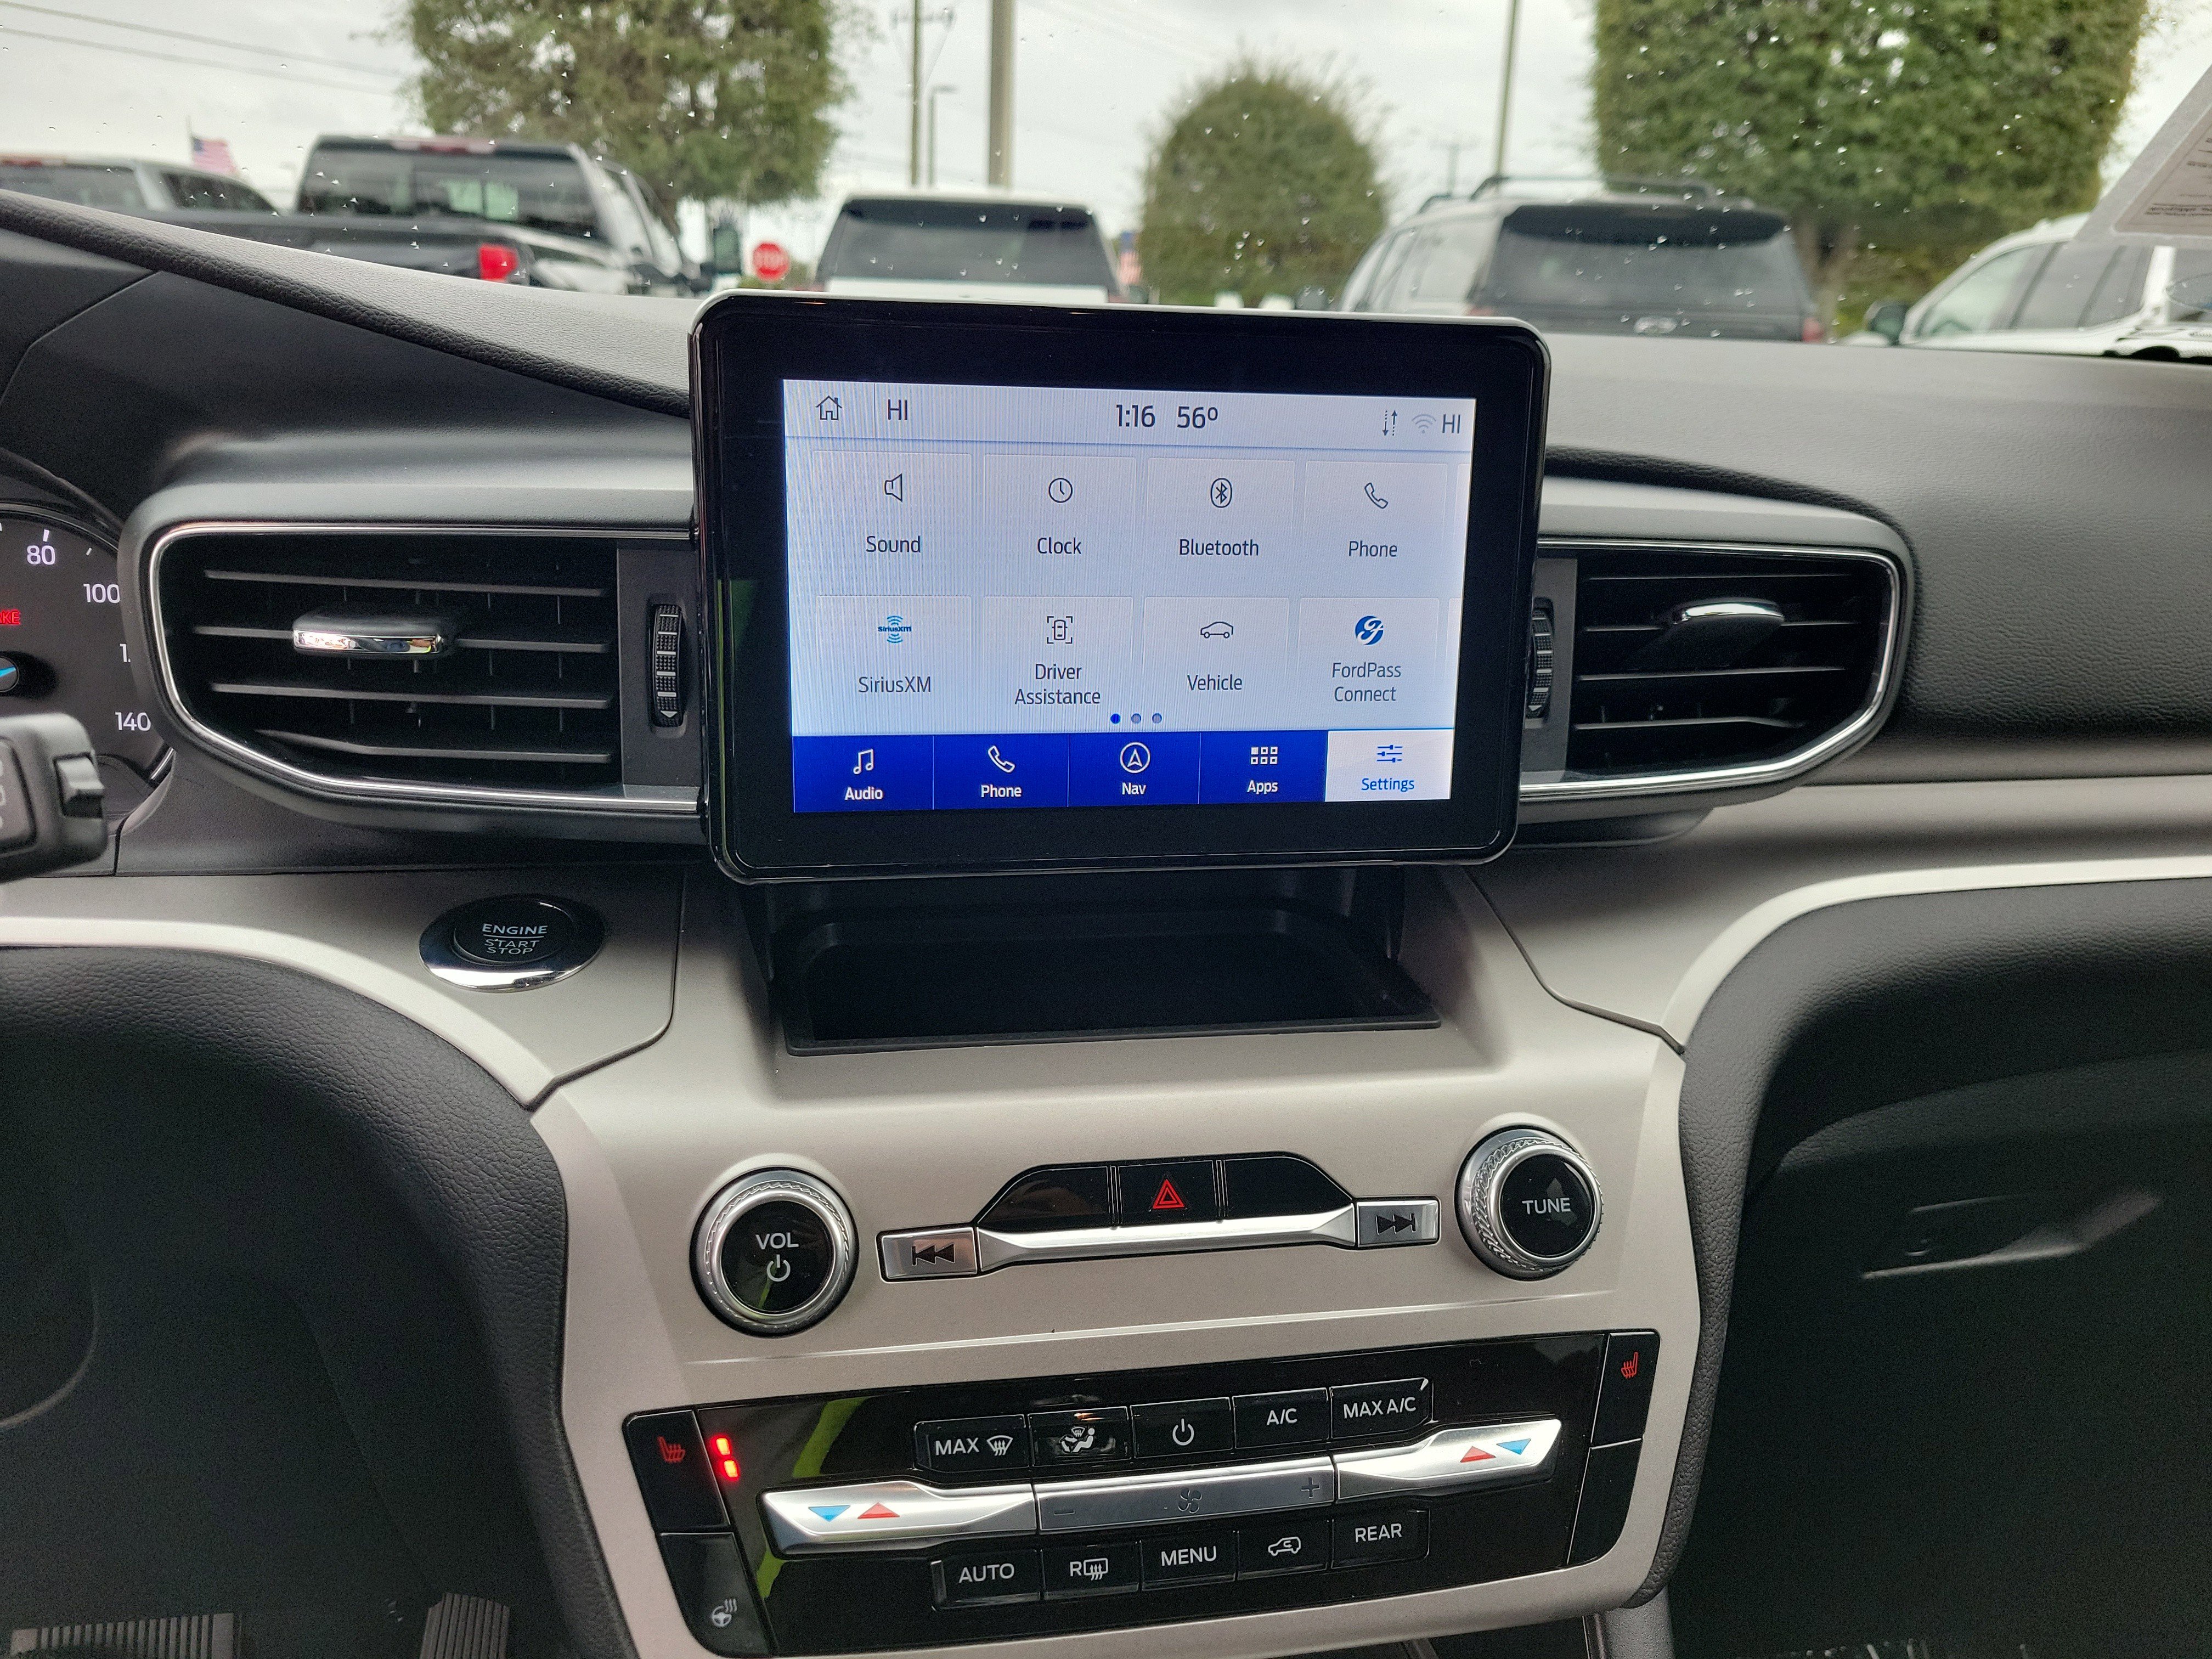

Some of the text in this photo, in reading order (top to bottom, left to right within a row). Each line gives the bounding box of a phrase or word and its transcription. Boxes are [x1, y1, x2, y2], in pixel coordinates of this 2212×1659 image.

[887, 399, 909, 421] HI
[1116, 404, 1155, 428] 1:16
[1441, 414, 1462, 434] HI
[866, 535, 922, 554] Sound
[1037, 537, 1082, 555] Clock
[1178, 539, 1260, 556] Bluetooth
[1348, 540, 1398, 558] Phone
[27, 545, 55, 566] 80
[83, 583, 121, 604] 100
[1034, 663, 1082, 680] Driver
[1331, 662, 1402, 679] FordPass
[857, 675, 932, 694] SiriusXM
[1187, 674, 1243, 691] Vehicle
[1014, 688, 1101, 705] Assistance
[1334, 685, 1397, 702] Connect
[115, 712, 151, 731] 140
[844, 787, 884, 800] Audio
[980, 785, 1023, 799] Phone
[1121, 782, 1147, 795] Nav
[1246, 779, 1279, 794] Apps
[1361, 777, 1415, 793] Settings
[482, 923, 548, 935] ENGINE
[484, 939, 540, 947] START
[486, 946, 533, 955] STOP
[1521, 1197, 1571, 1215] TUNE
[755, 1232, 799, 1250] VOL
[1344, 1396, 1417, 1419] MAX A/C
[1266, 1408, 1298, 1426] A/C
[935, 1437, 980, 1456] MAX
[1355, 1523, 1402, 1543] REAR
[1160, 1545, 1217, 1567] MENU
[958, 1563, 1015, 1584] AUTO
